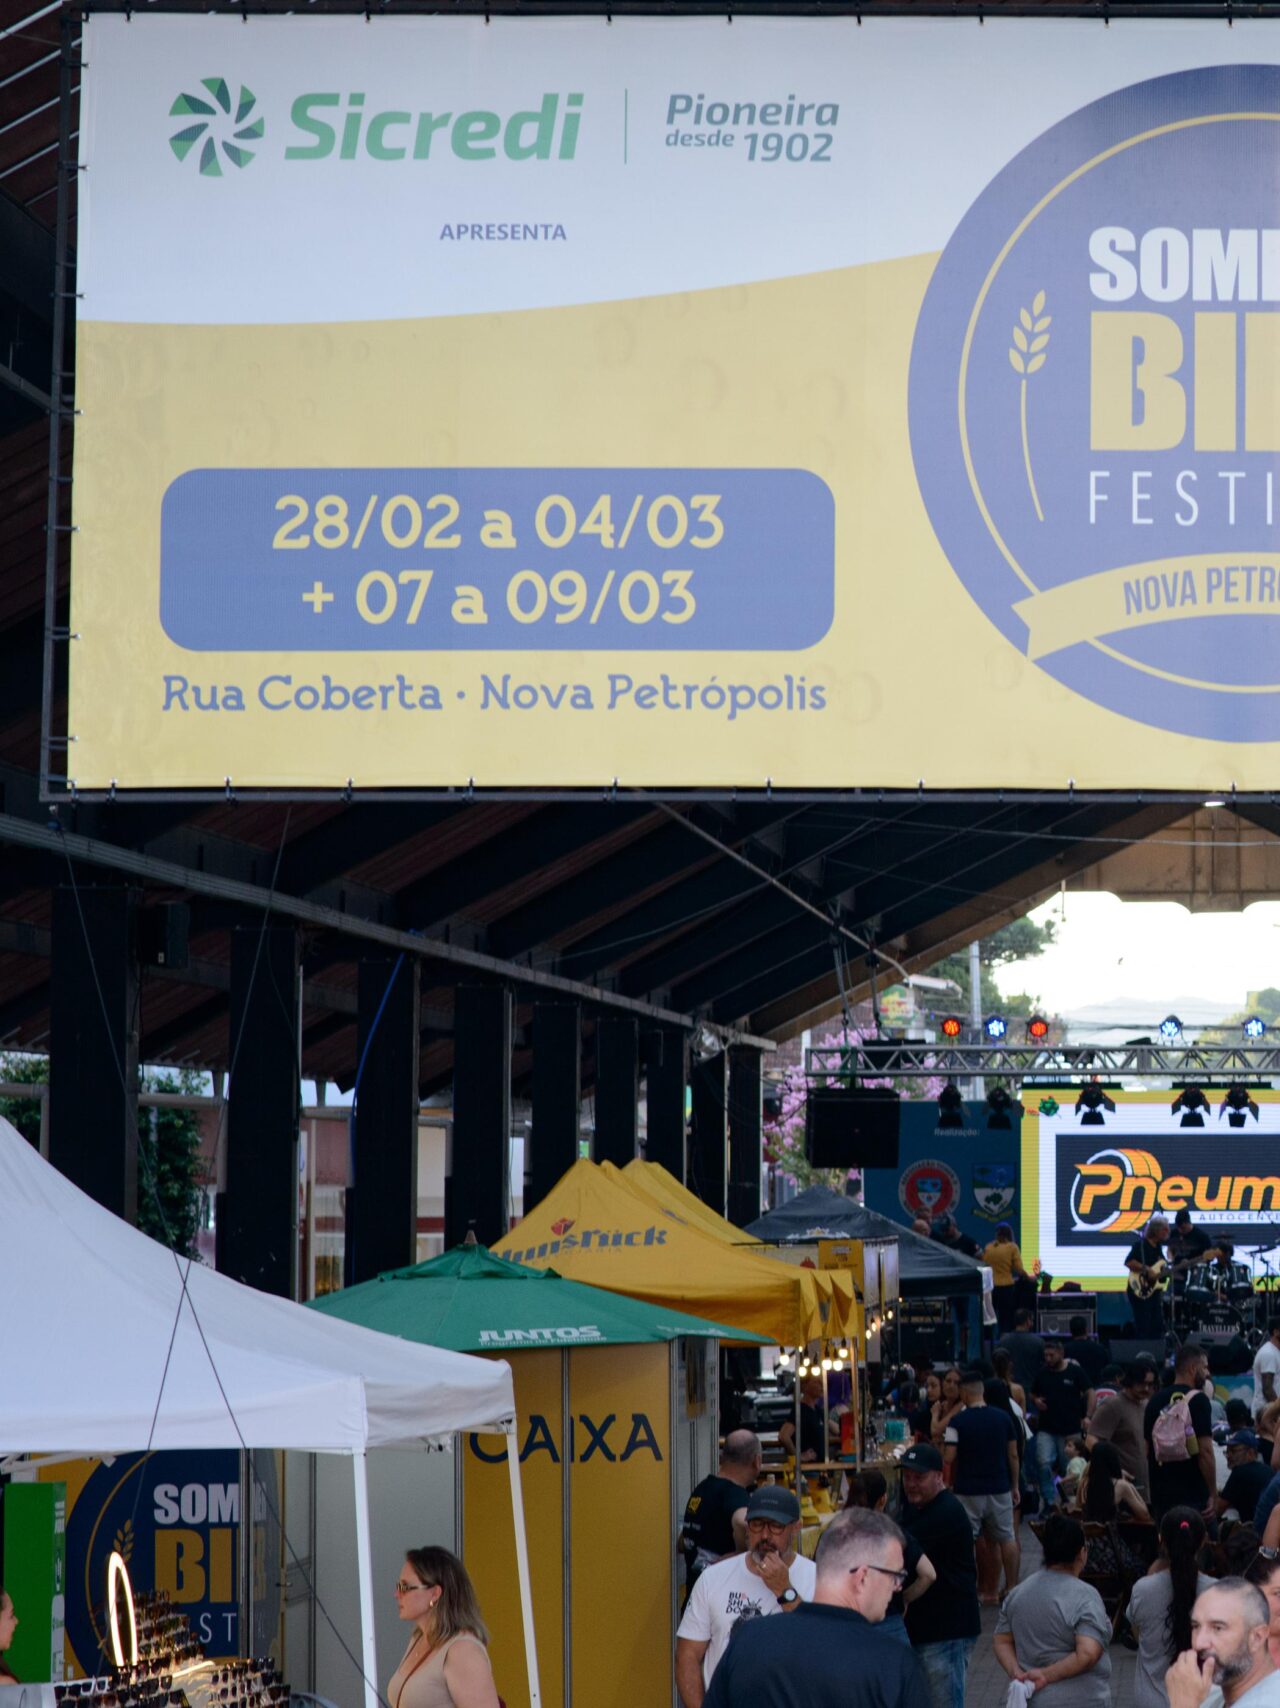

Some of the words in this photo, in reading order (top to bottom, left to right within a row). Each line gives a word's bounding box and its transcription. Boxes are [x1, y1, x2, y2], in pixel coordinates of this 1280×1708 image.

[285, 92, 584, 160] Sicredi
[666, 93, 839, 127] Pioneira
[666, 128, 735, 148] desde
[744, 132, 833, 162] 1902
[440, 224, 567, 241] APRESENTA
[272, 494, 461, 549] 28/02
[480, 509, 516, 548] a
[535, 494, 725, 549] 04/03
[355, 570, 434, 624] 07
[451, 585, 488, 624] a
[506, 570, 697, 625] 09/03
[1123, 578, 1197, 616] NOVA
[162, 674, 246, 711] Rua
[257, 674, 442, 711] Coberta
[480, 674, 594, 710] Nova
[607, 674, 827, 721] Petrópolis
[479, 1326, 600, 1341] JUNTOS
[154, 1528, 241, 1604] BI
